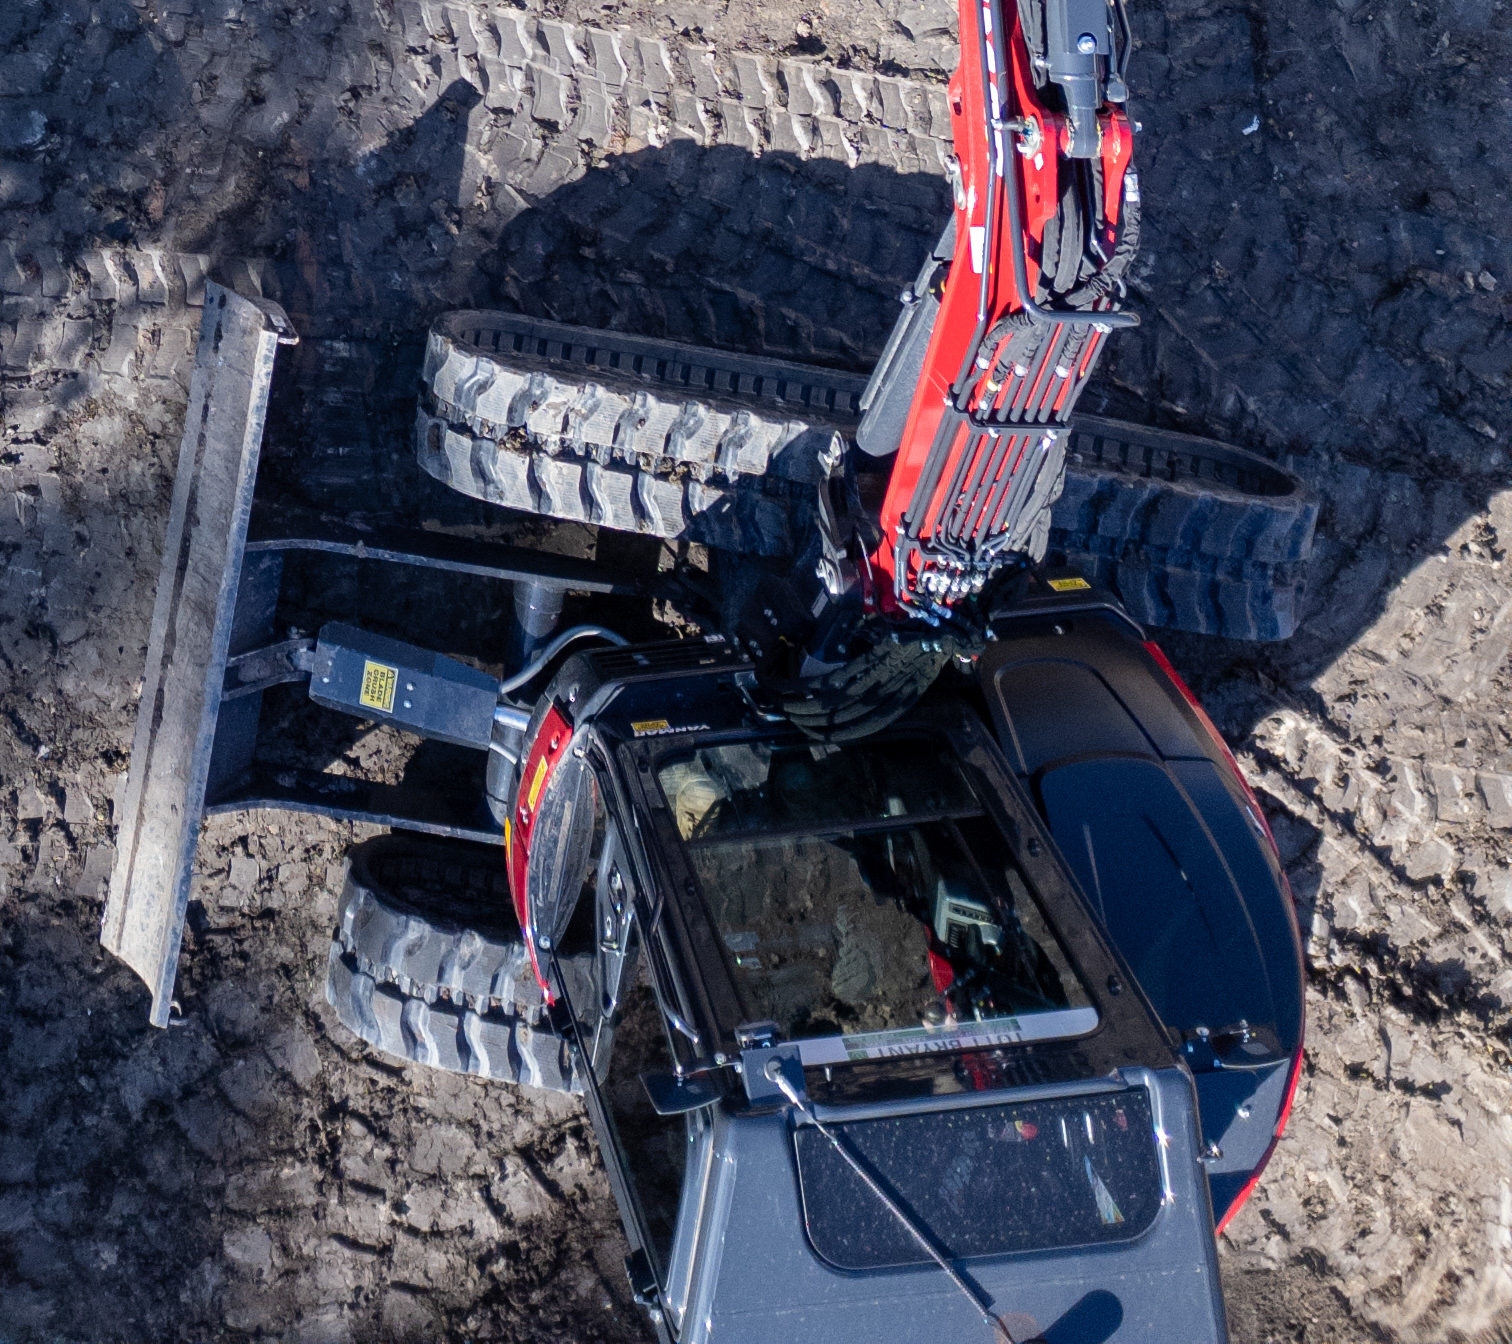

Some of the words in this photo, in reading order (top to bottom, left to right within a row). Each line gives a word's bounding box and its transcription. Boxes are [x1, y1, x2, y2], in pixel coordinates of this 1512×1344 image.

[363, 670, 372, 697] ZONE
[369, 669, 379, 702] CRUSH
[376, 672, 385, 702] BLADE
[877, 1039, 962, 1058] BRYANT
